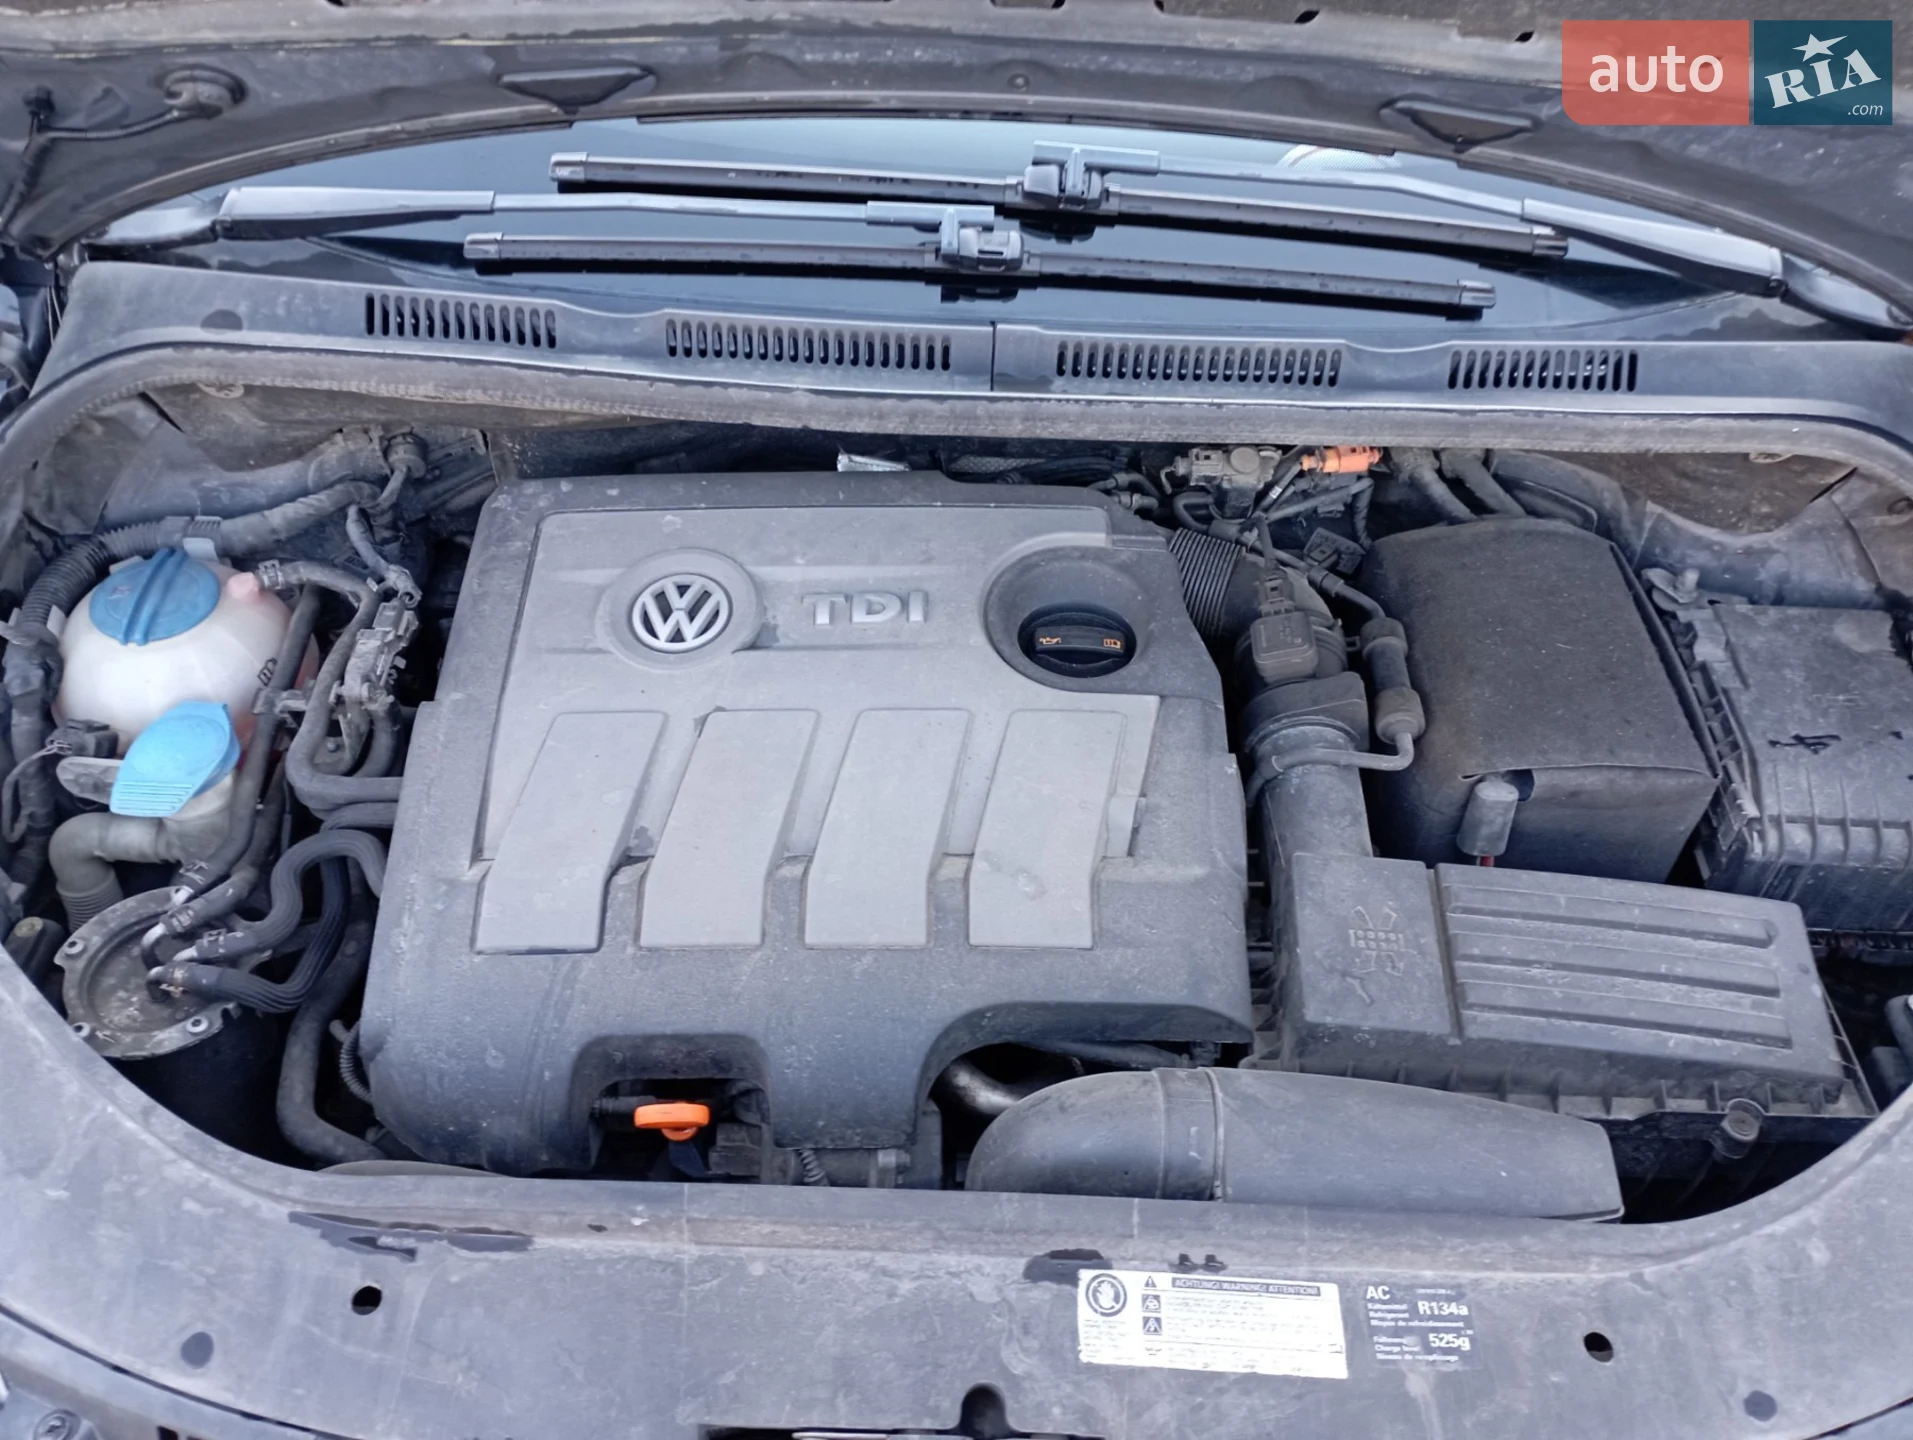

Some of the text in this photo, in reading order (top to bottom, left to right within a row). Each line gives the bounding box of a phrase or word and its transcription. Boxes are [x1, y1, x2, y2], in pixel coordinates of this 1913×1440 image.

[802, 591, 928, 627] TDI
[1366, 1285, 1391, 1300] AC
[1417, 1300, 1469, 1316] R134a
[1428, 1332, 1471, 1351] 525g
